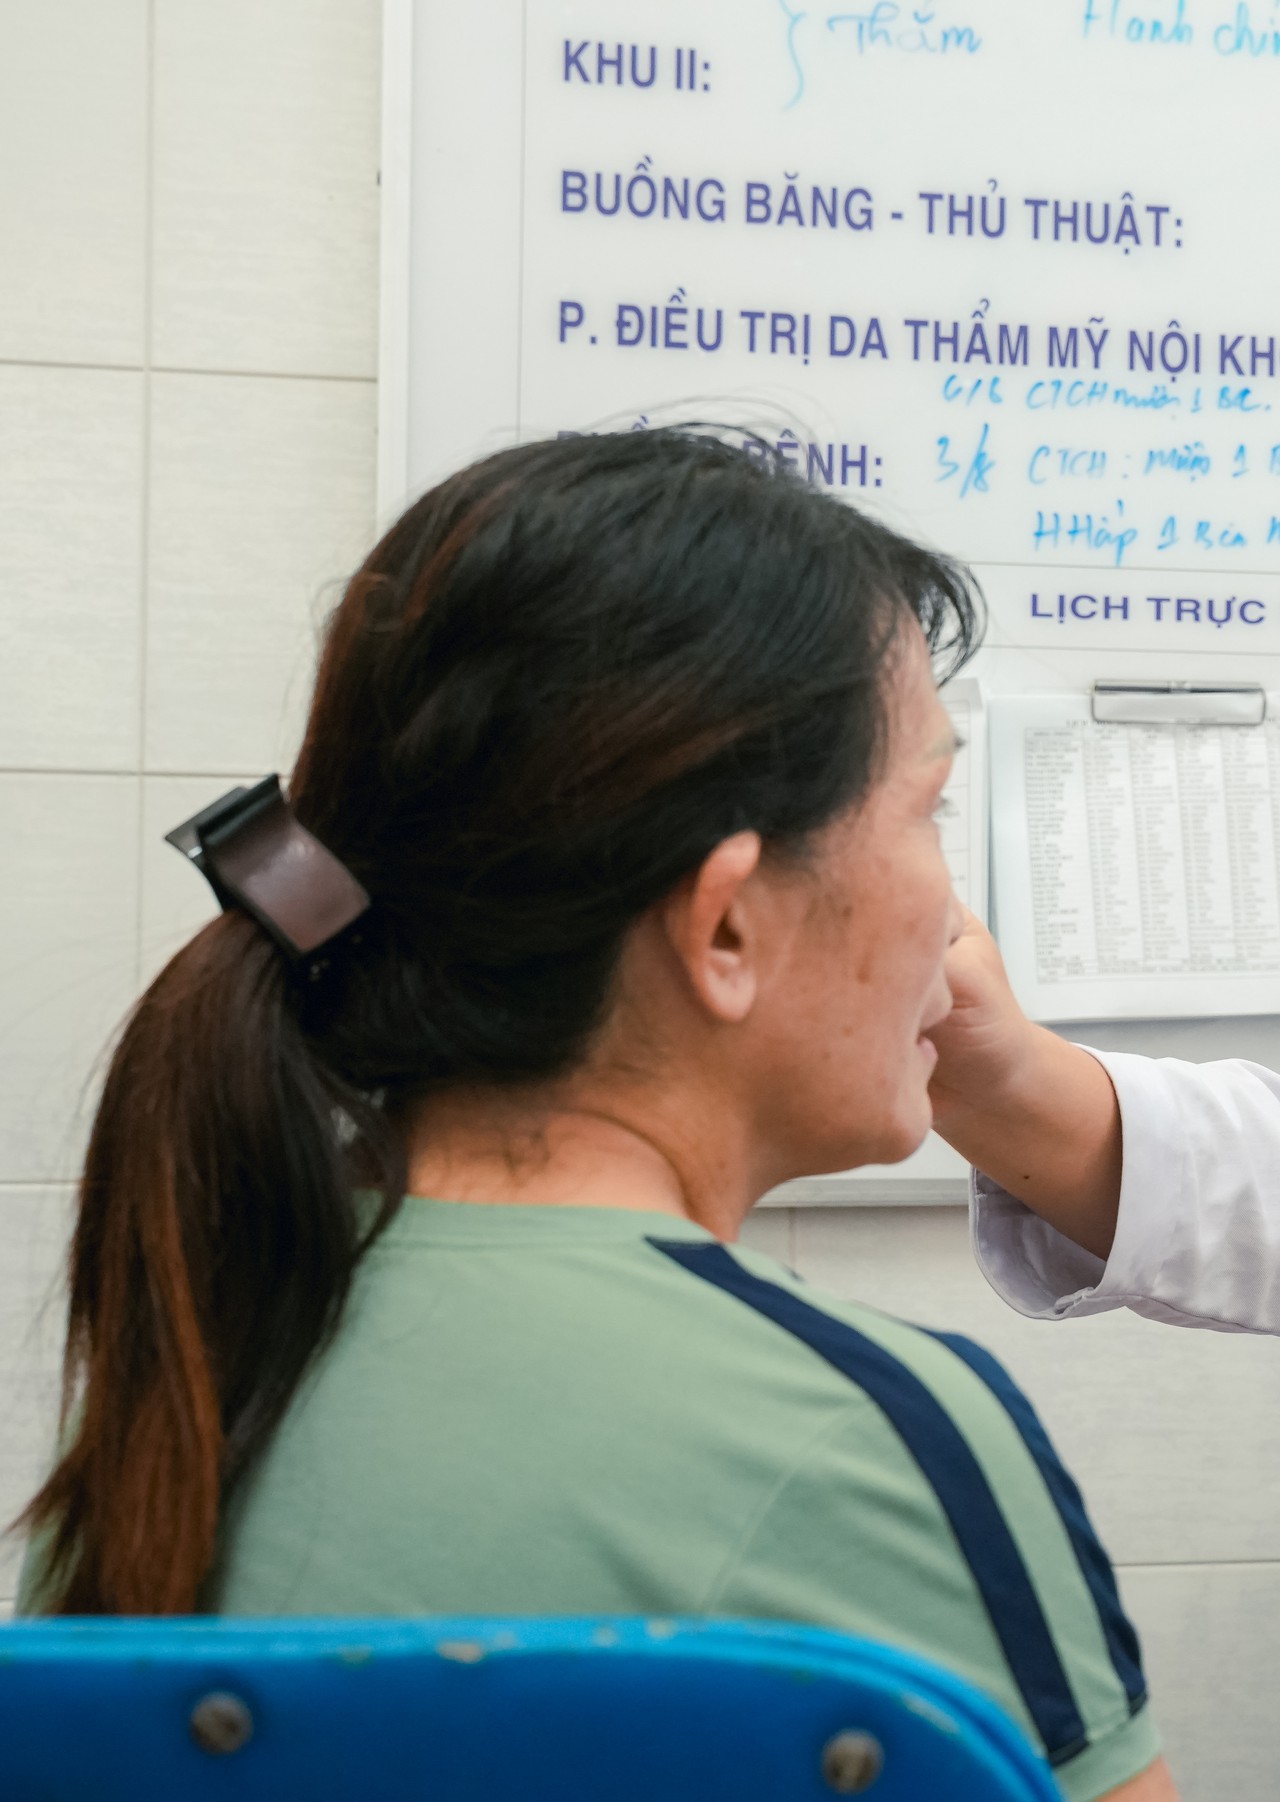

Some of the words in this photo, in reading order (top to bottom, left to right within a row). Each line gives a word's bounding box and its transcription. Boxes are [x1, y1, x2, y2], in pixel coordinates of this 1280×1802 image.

[563, 39, 657, 89] KHU
[675, 48, 711, 92] II:
[562, 155, 726, 222] BUỒNG
[745, 172, 873, 231] BĂNG
[919, 179, 1007, 238] THỦ
[1024, 192, 1183, 255] THUẬT:
[559, 300, 598, 345] P.
[616, 288, 722, 352] ĐIỀU
[741, 310, 811, 364] TRỊ
[829, 315, 889, 361] DA
[905, 298, 1029, 367] THẨM
[1048, 317, 1109, 370] MỸ
[1128, 320, 1201, 383] NỘI
[1031, 593, 1130, 624] LỊCH
[1146, 596, 1266, 628] TRỰC
